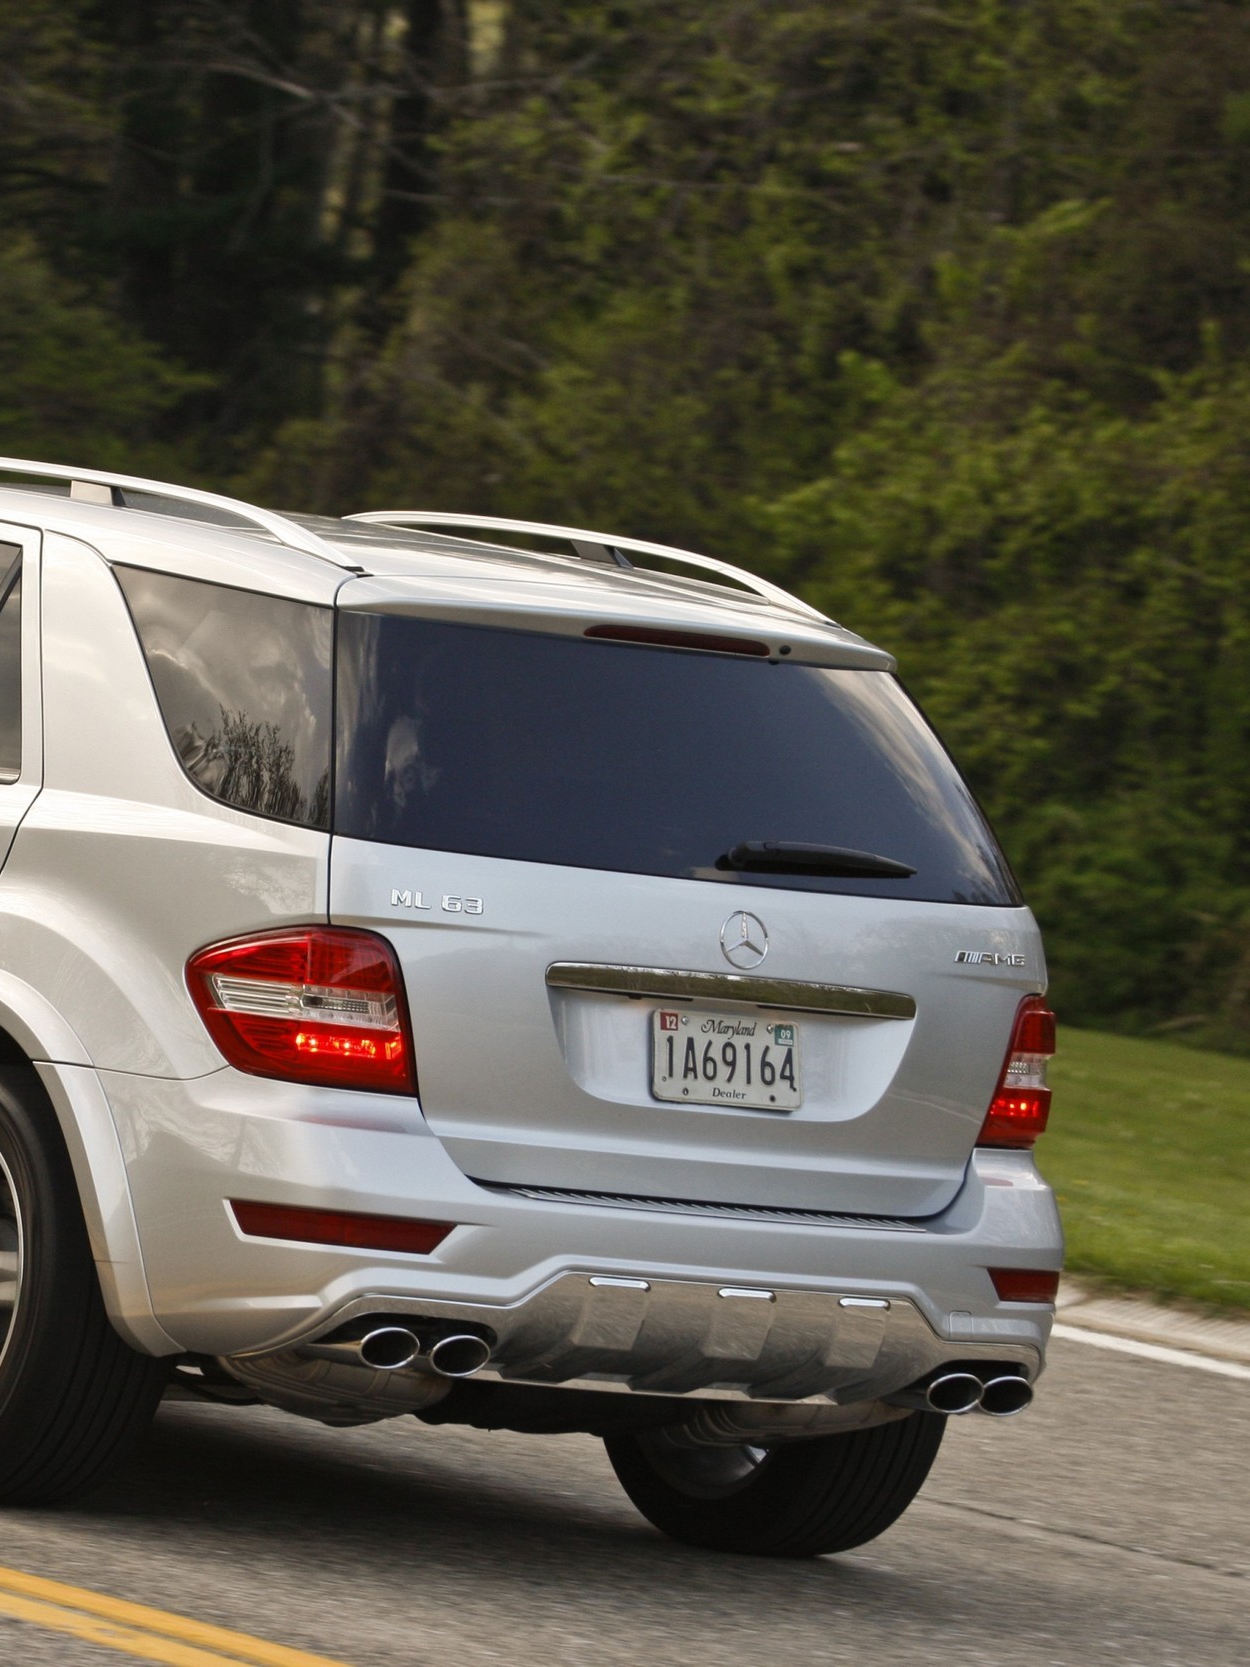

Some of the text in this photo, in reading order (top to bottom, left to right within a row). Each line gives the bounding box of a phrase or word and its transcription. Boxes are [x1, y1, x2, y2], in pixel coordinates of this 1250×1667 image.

[391, 888, 484, 914] ML 63
[665, 1015, 677, 1029] 12
[701, 1019, 757, 1040] Maryland
[780, 1029, 791, 1039] 09
[666, 1035, 796, 1091] 1A69164
[712, 1087, 747, 1100] Dealer
